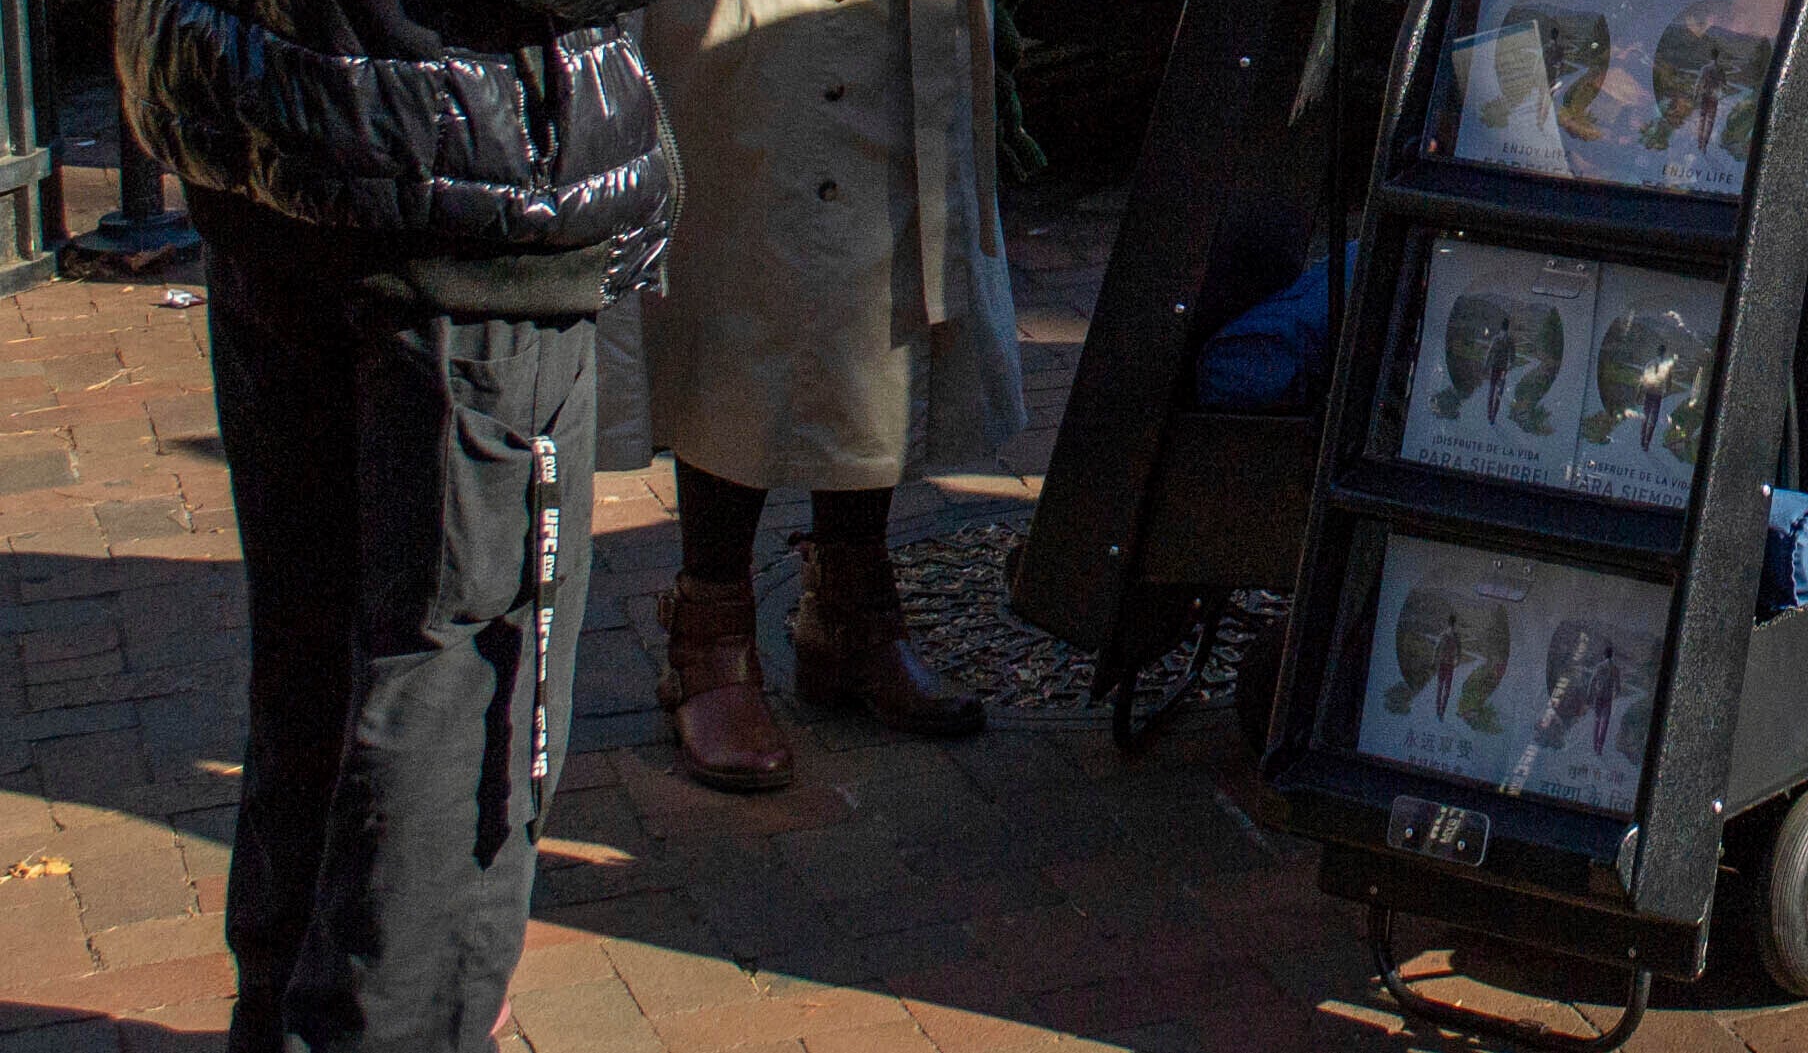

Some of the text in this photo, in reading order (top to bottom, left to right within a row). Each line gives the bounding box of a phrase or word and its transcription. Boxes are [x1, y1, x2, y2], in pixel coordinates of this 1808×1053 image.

[1503, 141, 1541, 157] ENJOY
[1662, 163, 1735, 184] ENJOY LIFE
[1418, 447, 1462, 470] PARA
[1486, 443, 1498, 454] DE
[1502, 445, 1514, 457] LA
[1519, 448, 1540, 462] VIDA
[1639, 470, 1652, 482] DE
[1656, 474, 1668, 486] LA
[540, 507, 560, 553] UFC
